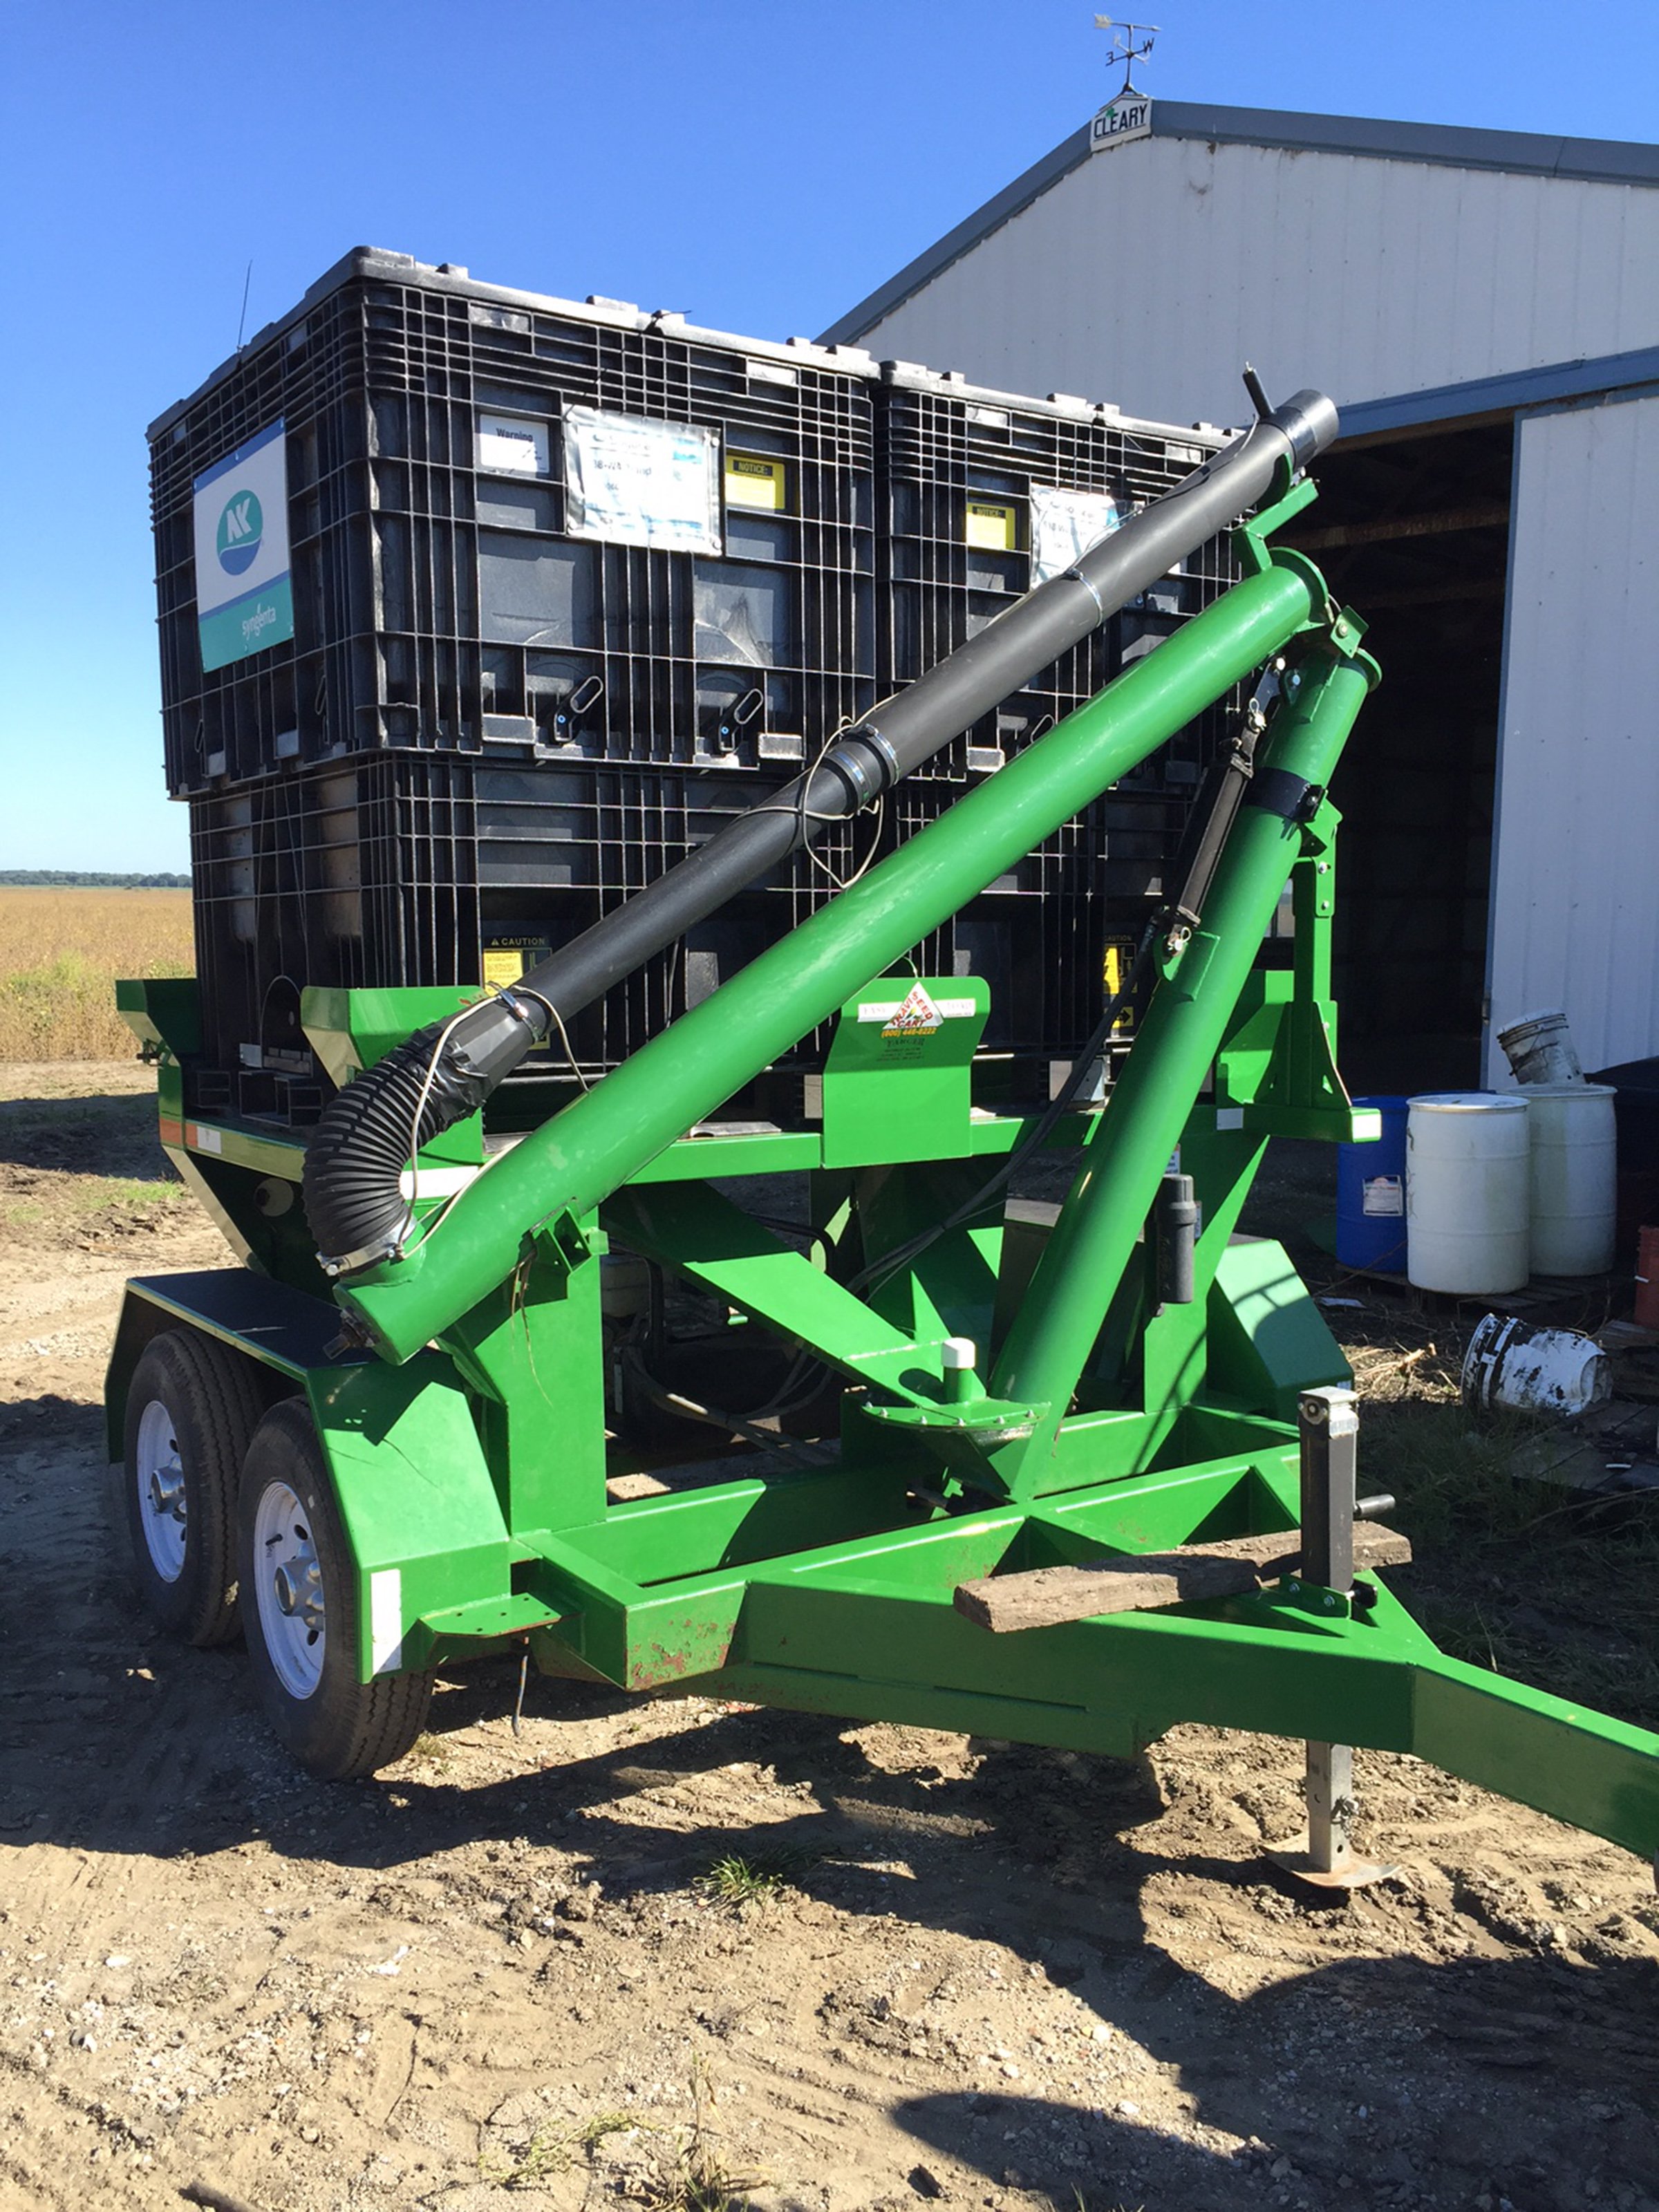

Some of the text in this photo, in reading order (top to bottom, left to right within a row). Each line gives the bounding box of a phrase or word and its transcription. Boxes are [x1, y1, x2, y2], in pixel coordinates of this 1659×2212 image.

[1094, 103, 1147, 138] CLEARY
[496, 428, 534, 442] Warning
[241, 603, 277, 641] syngenta
[501, 937, 545, 946] CAUTION
[897, 1019, 927, 1029] CART
